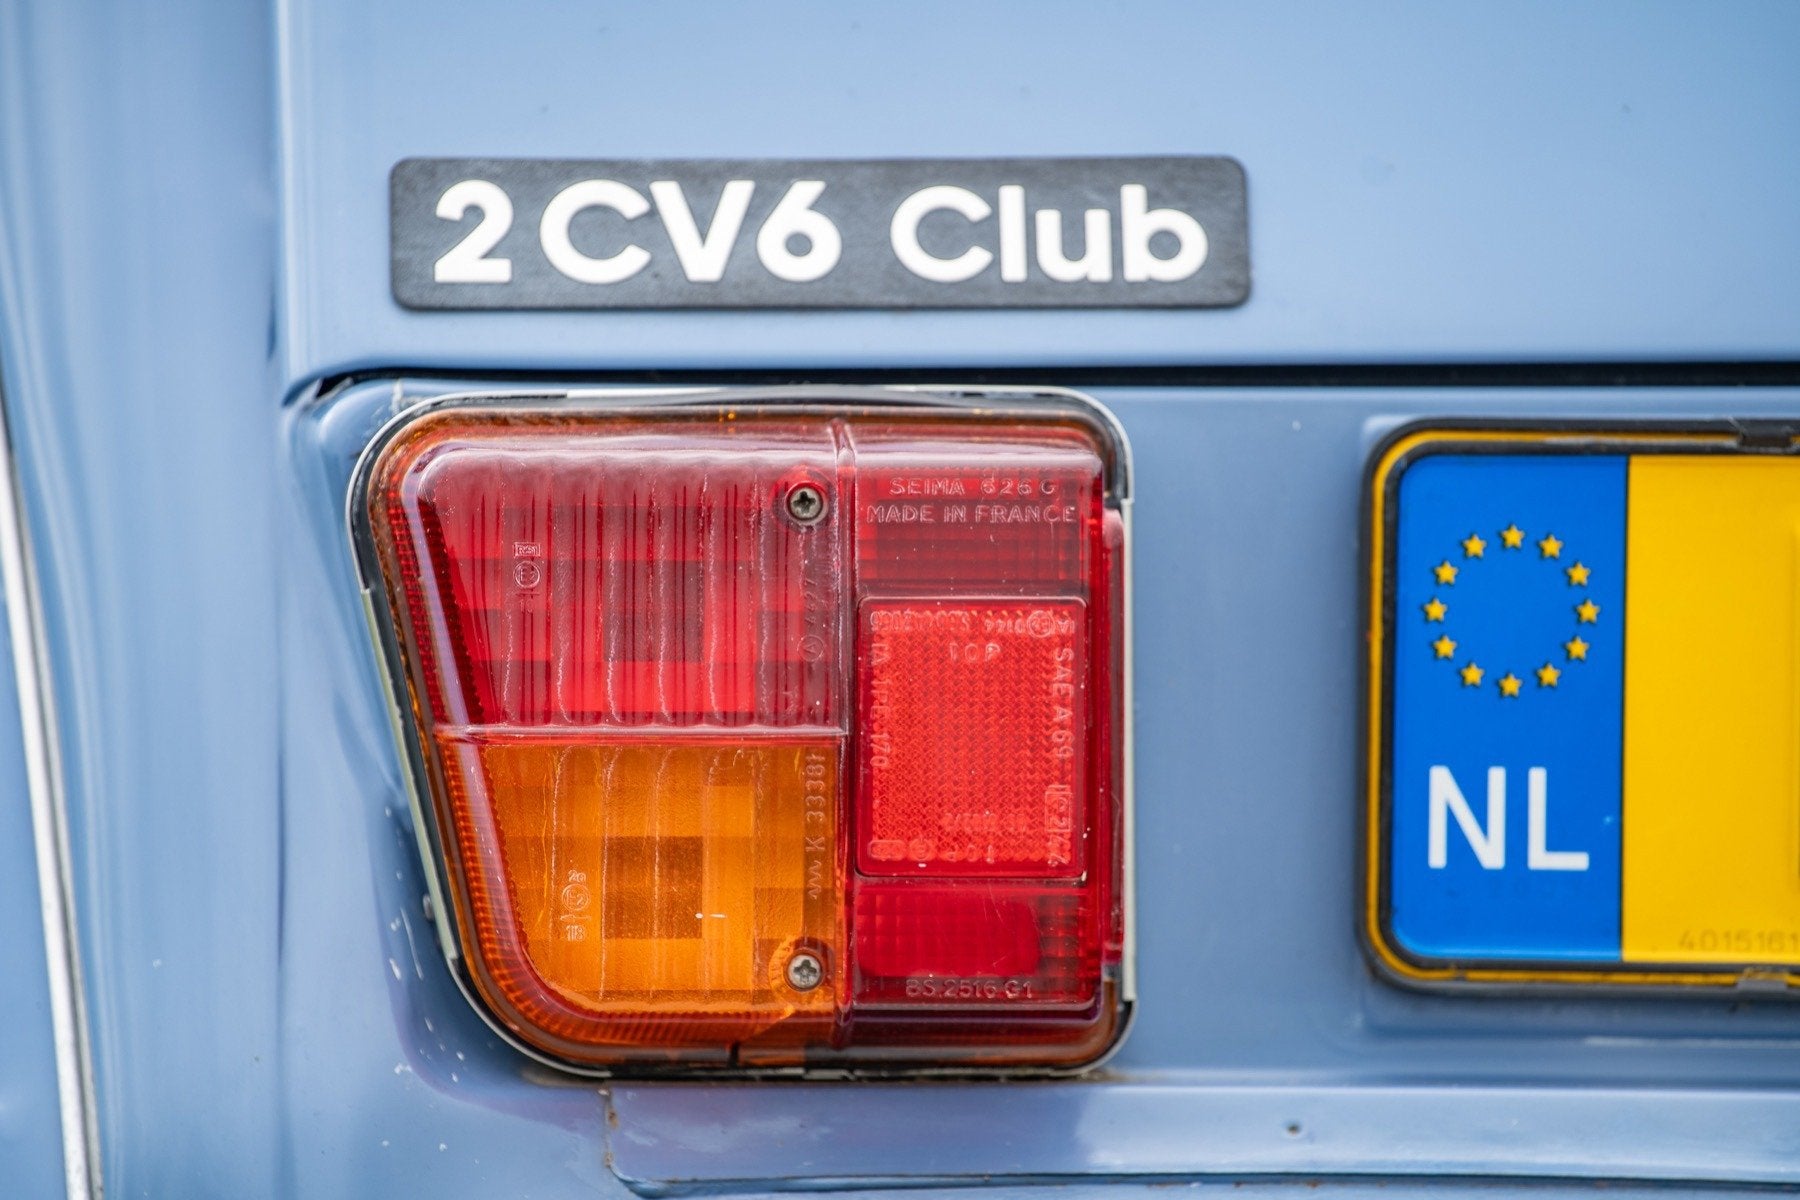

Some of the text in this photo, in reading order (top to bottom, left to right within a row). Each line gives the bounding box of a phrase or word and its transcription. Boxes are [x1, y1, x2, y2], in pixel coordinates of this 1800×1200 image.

[890, 184, 1209, 283] Club
[866, 504, 1077, 524] MADE IN FRANCE
[889, 478, 965, 495] SEIMA
[1428, 766, 1589, 870] NL
